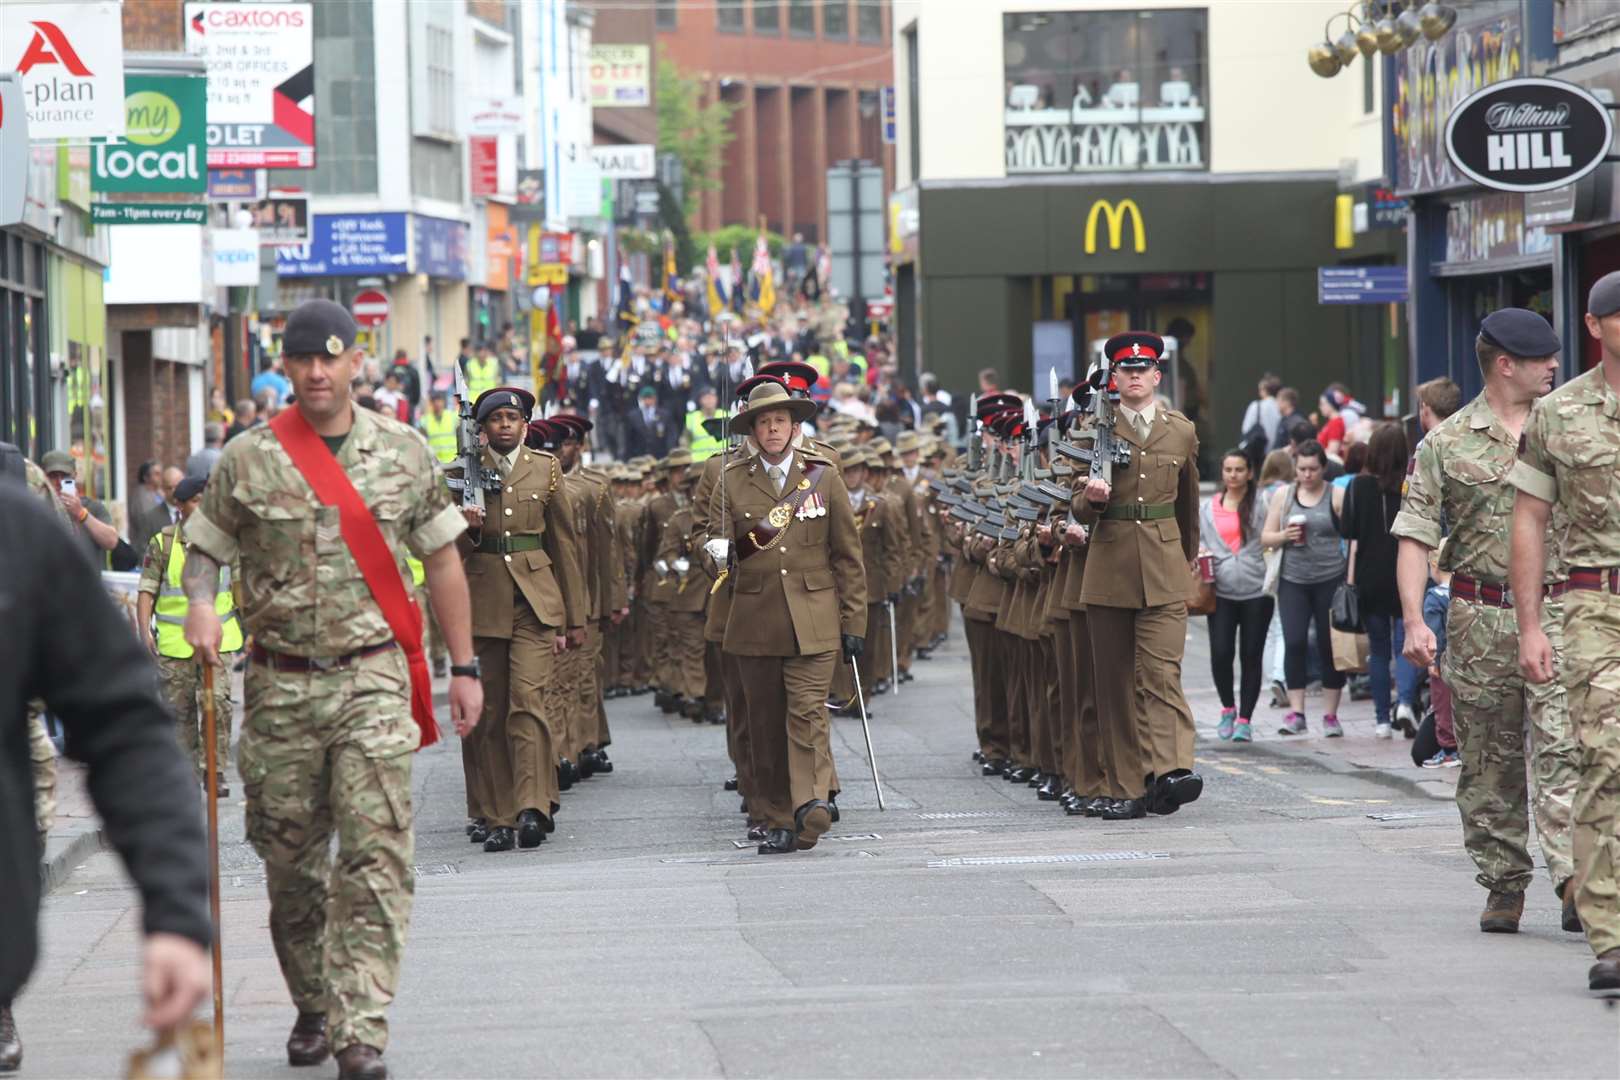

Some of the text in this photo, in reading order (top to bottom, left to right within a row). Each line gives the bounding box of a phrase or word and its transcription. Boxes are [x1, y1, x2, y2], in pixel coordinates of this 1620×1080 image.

[208, 10, 304, 27] caxtons
[127, 104, 169, 138] my
[1485, 102, 1572, 132] William
[224, 125, 265, 146] LET
[96, 143, 199, 180] local
[1487, 131, 1572, 171] HILL
[93, 206, 117, 218] 7am
[151, 208, 182, 221] every
[183, 208, 205, 221] day
